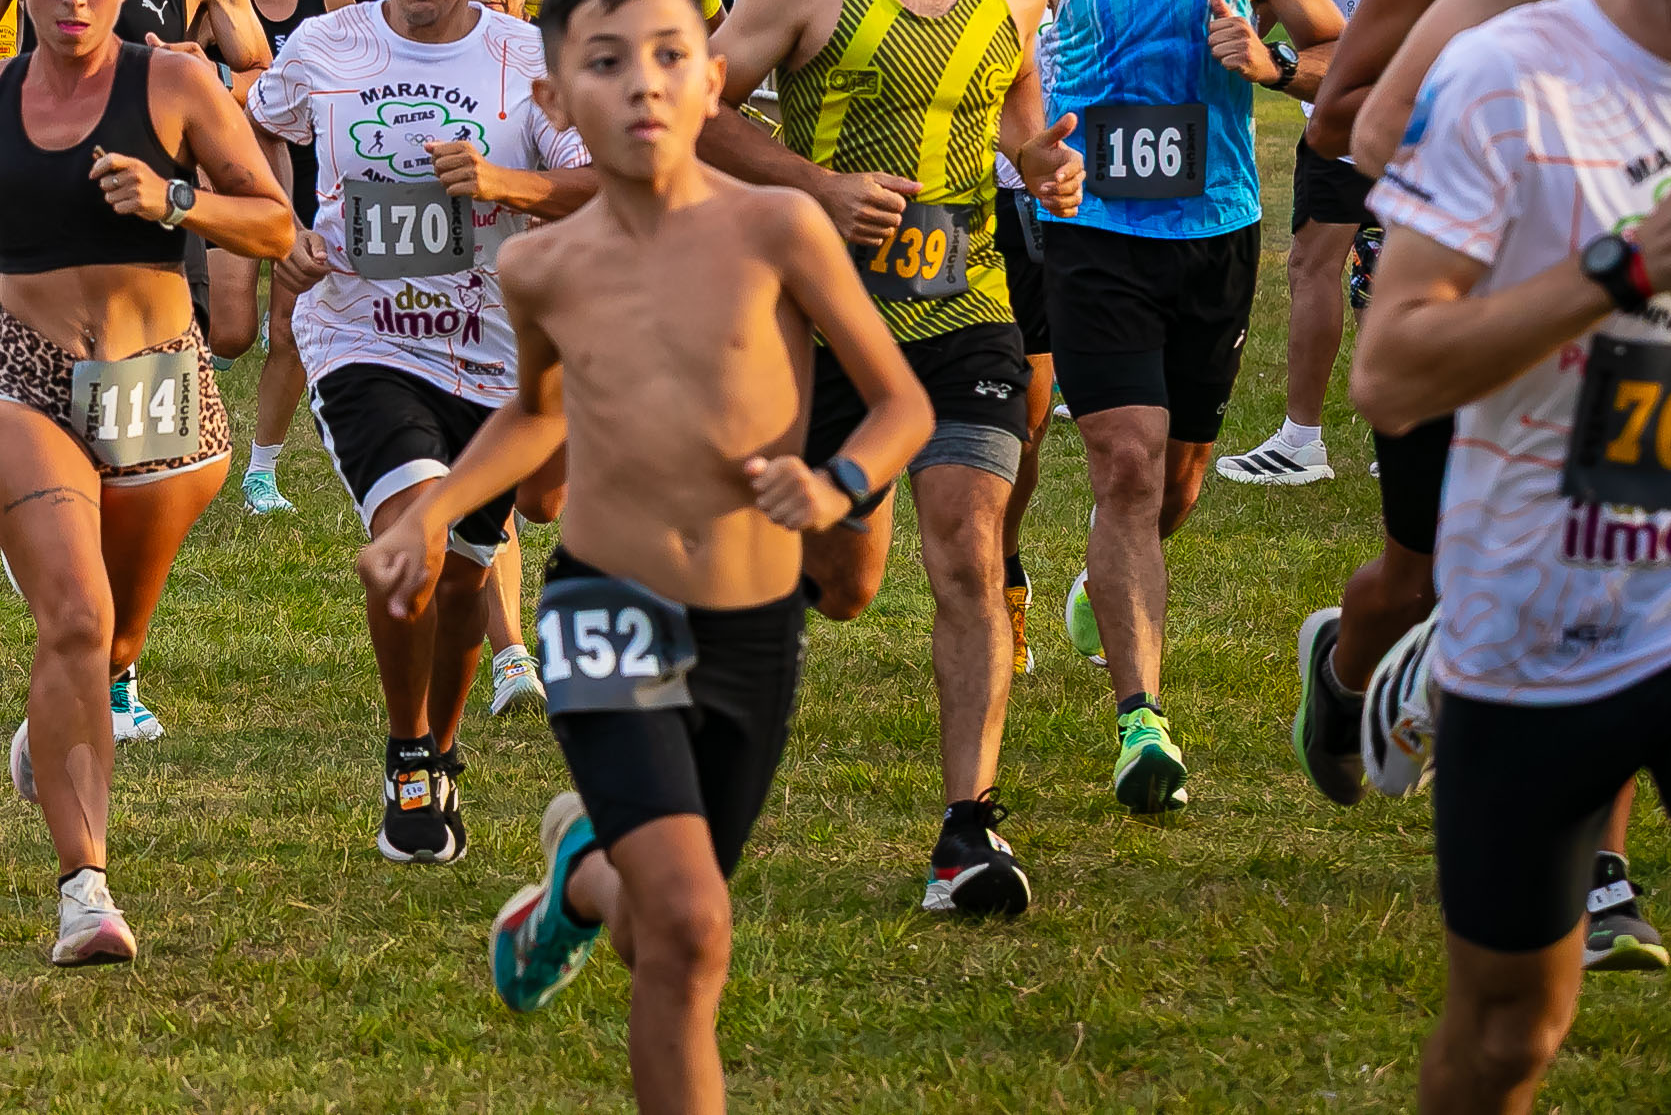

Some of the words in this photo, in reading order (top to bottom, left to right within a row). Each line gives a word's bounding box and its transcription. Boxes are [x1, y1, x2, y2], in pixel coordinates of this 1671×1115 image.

[359, 82, 479, 113] MARATÓN
[392, 110, 435, 125] ATLETAS
[403, 159, 416, 169] EL
[1109, 127, 1182, 178] 166
[352, 196, 364, 257] TIEMPO
[366, 202, 449, 255] 170
[373, 297, 460, 337] ilmo
[395, 283, 453, 311] don
[98, 378, 177, 440] 114
[179, 372, 191, 436] EXACTO
[537, 607, 660, 684] 152
